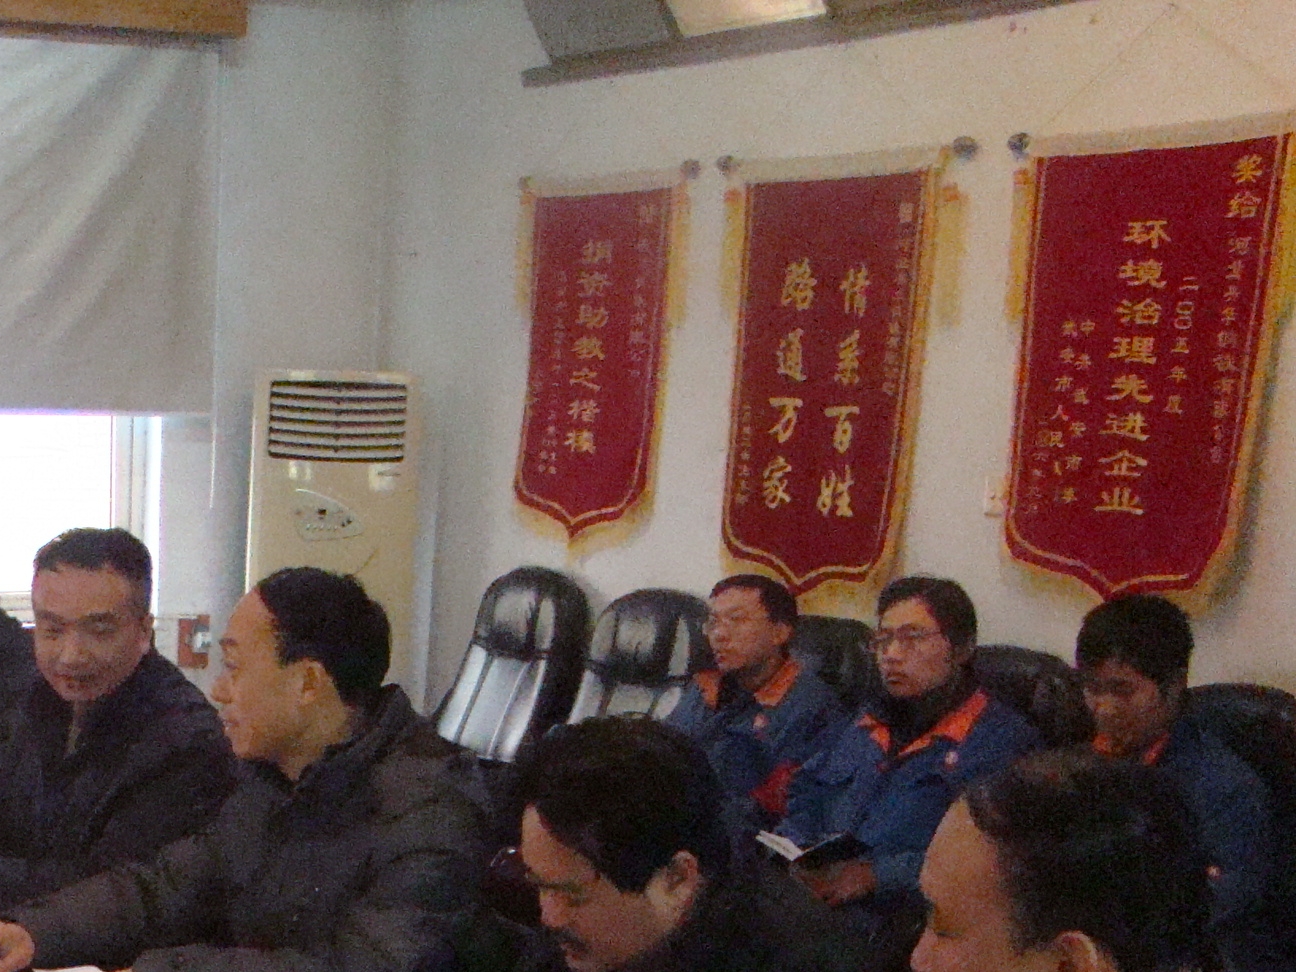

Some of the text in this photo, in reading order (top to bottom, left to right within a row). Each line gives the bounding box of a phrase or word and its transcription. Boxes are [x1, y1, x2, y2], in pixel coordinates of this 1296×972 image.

[563, 239, 614, 454] 捐资助教之楷模
[761, 257, 818, 510] 路通万家
[816, 262, 871, 518] 情系百姓
[1093, 219, 1172, 515] 环境治理先进企业
